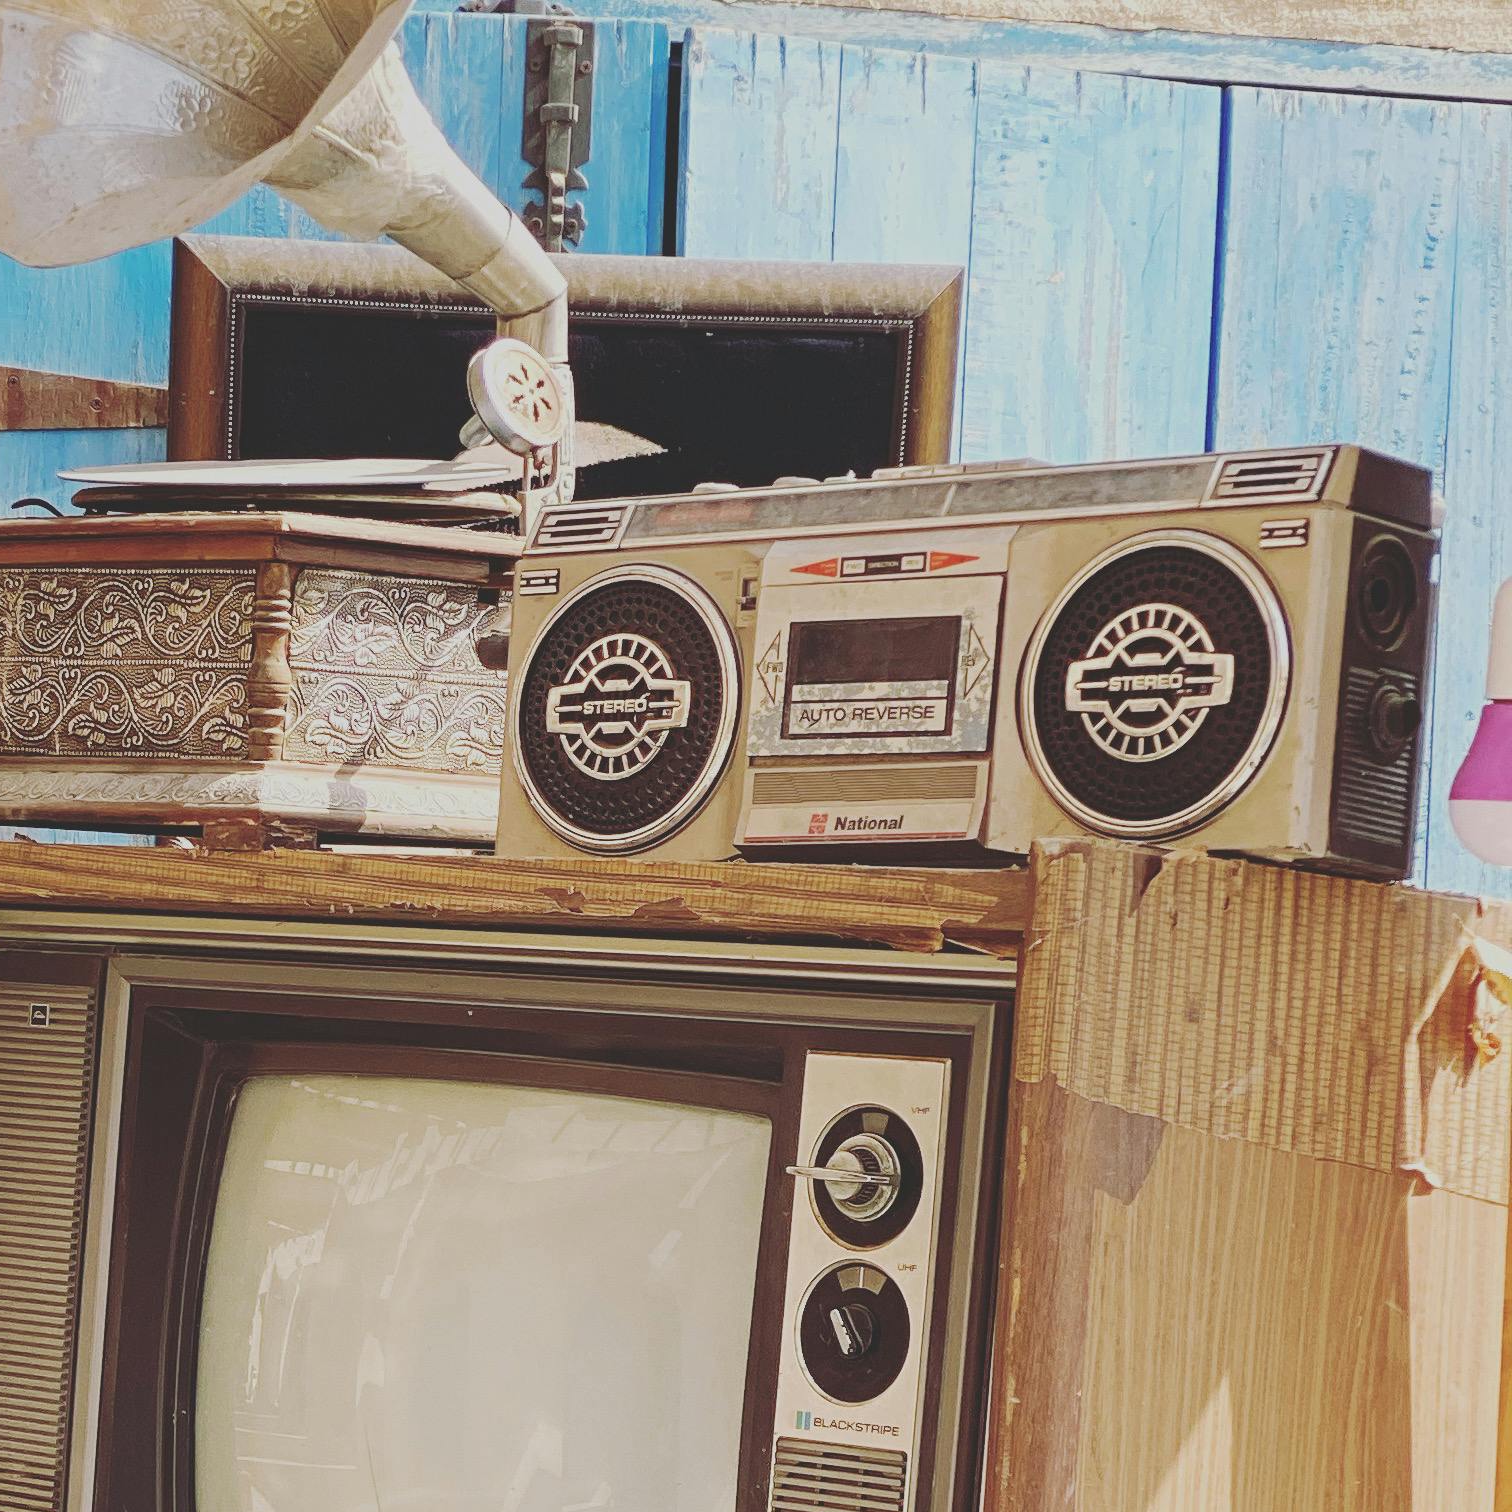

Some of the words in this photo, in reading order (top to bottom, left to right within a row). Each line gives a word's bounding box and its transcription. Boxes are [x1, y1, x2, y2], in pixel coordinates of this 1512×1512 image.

[1107, 674, 1184, 691] STEREO
[583, 698, 648, 715] STEREO
[798, 708, 847, 727] AUTO
[851, 705, 936, 721] REVERSE
[834, 815, 904, 831] National
[813, 1416, 900, 1437] BLACKSTRIPE
